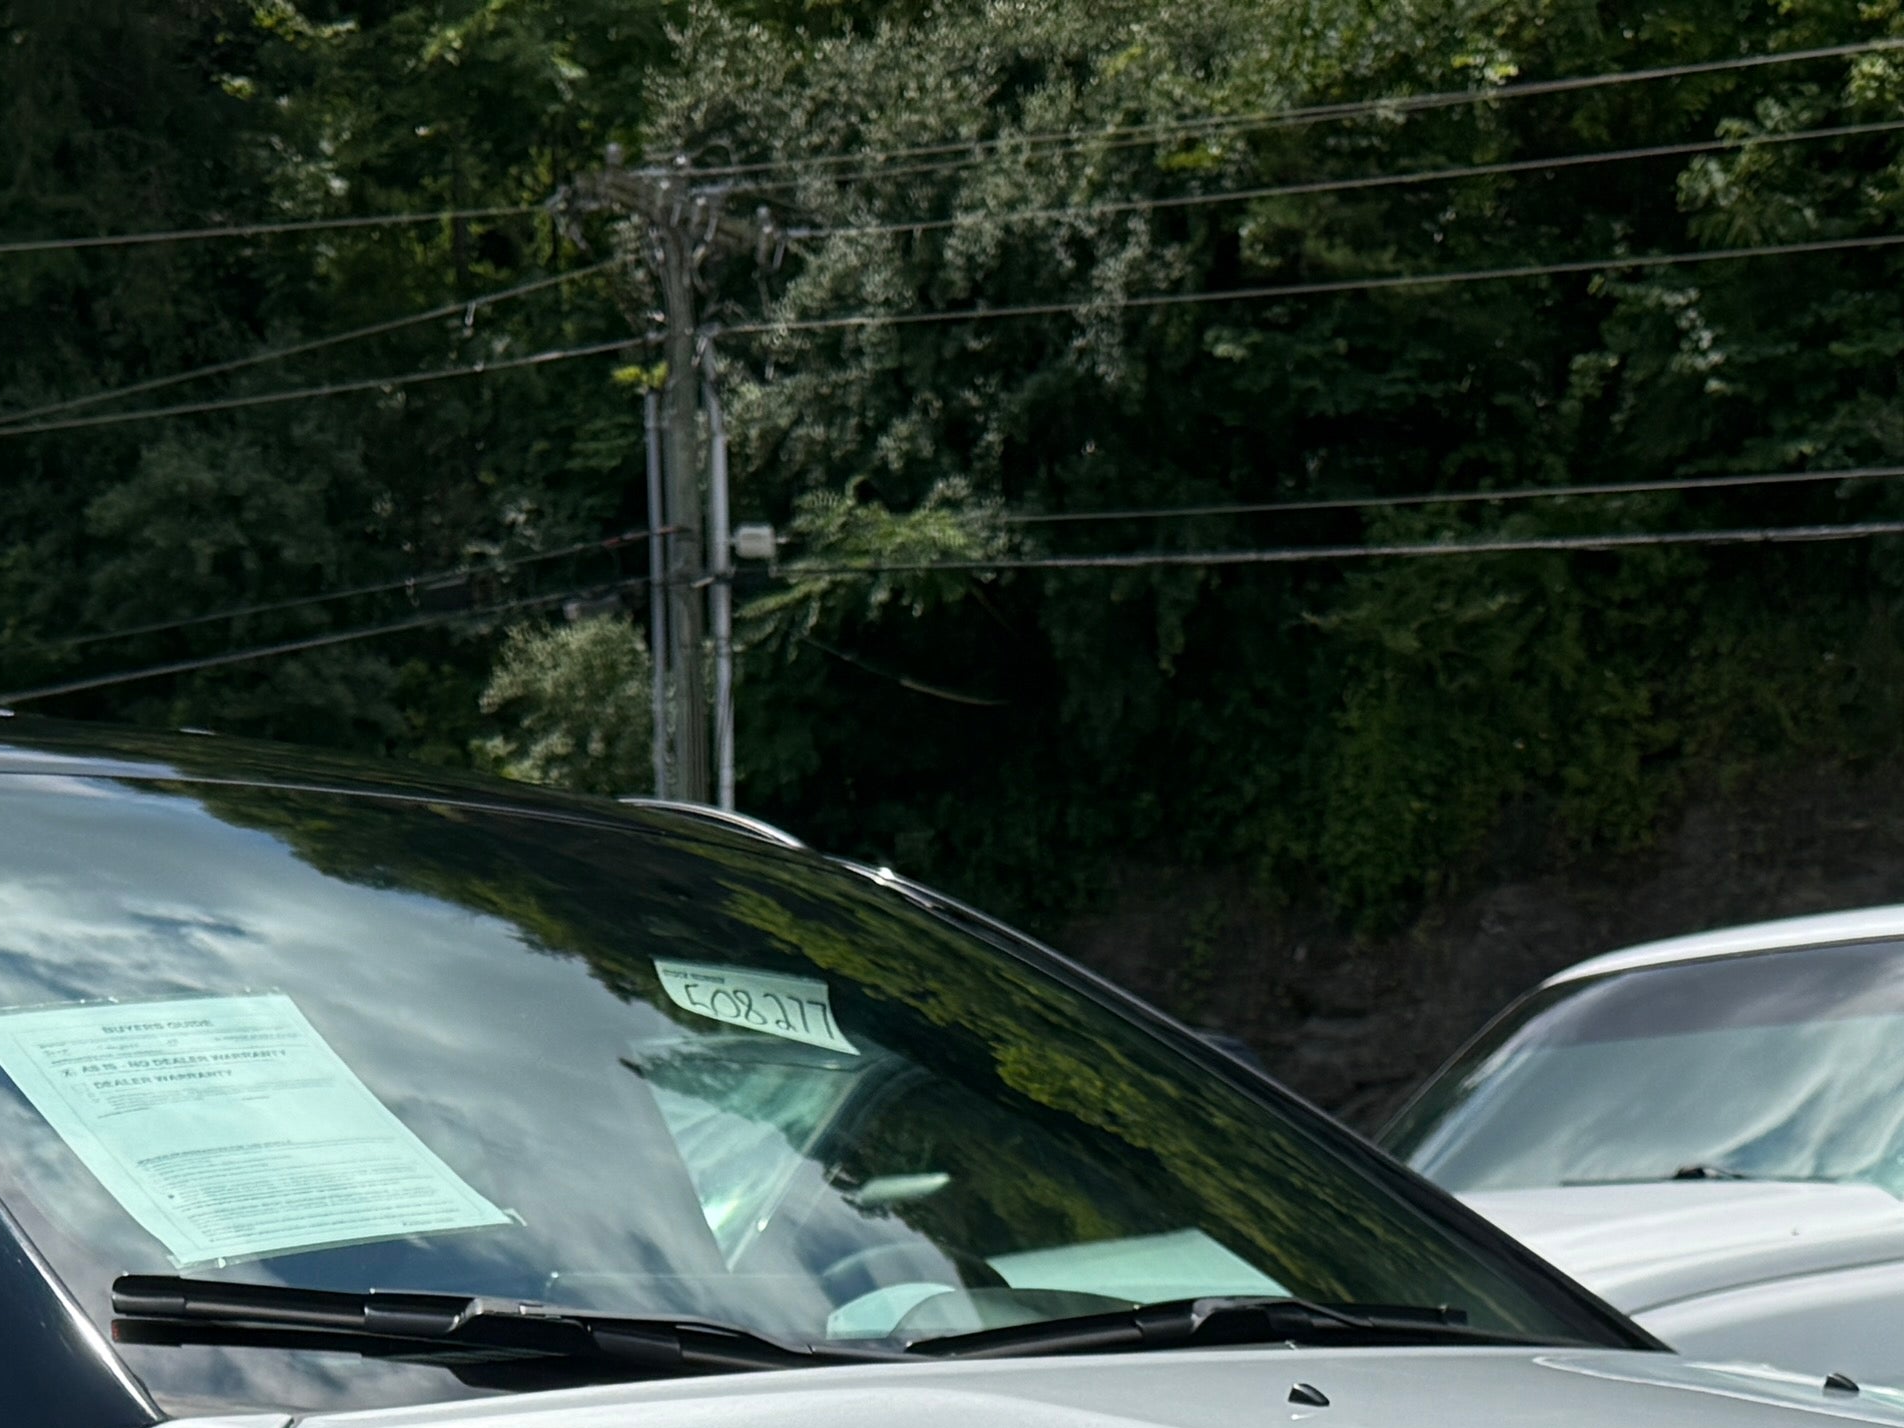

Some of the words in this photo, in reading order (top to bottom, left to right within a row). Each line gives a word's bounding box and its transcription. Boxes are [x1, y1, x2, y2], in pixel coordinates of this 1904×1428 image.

[684, 983, 835, 1040] 508277
[101, 1022, 165, 1034] BUYERS
[166, 1019, 215, 1030] GUIDE
[82, 1063, 100, 1074] AS
[103, 1062, 118, 1072] IS
[128, 1059, 150, 1069] NO
[152, 1054, 210, 1067] DEALER
[210, 1049, 288, 1062] WARRANTY
[93, 1076, 152, 1089] DEALER
[155, 1069, 233, 1083] WARRANTY
